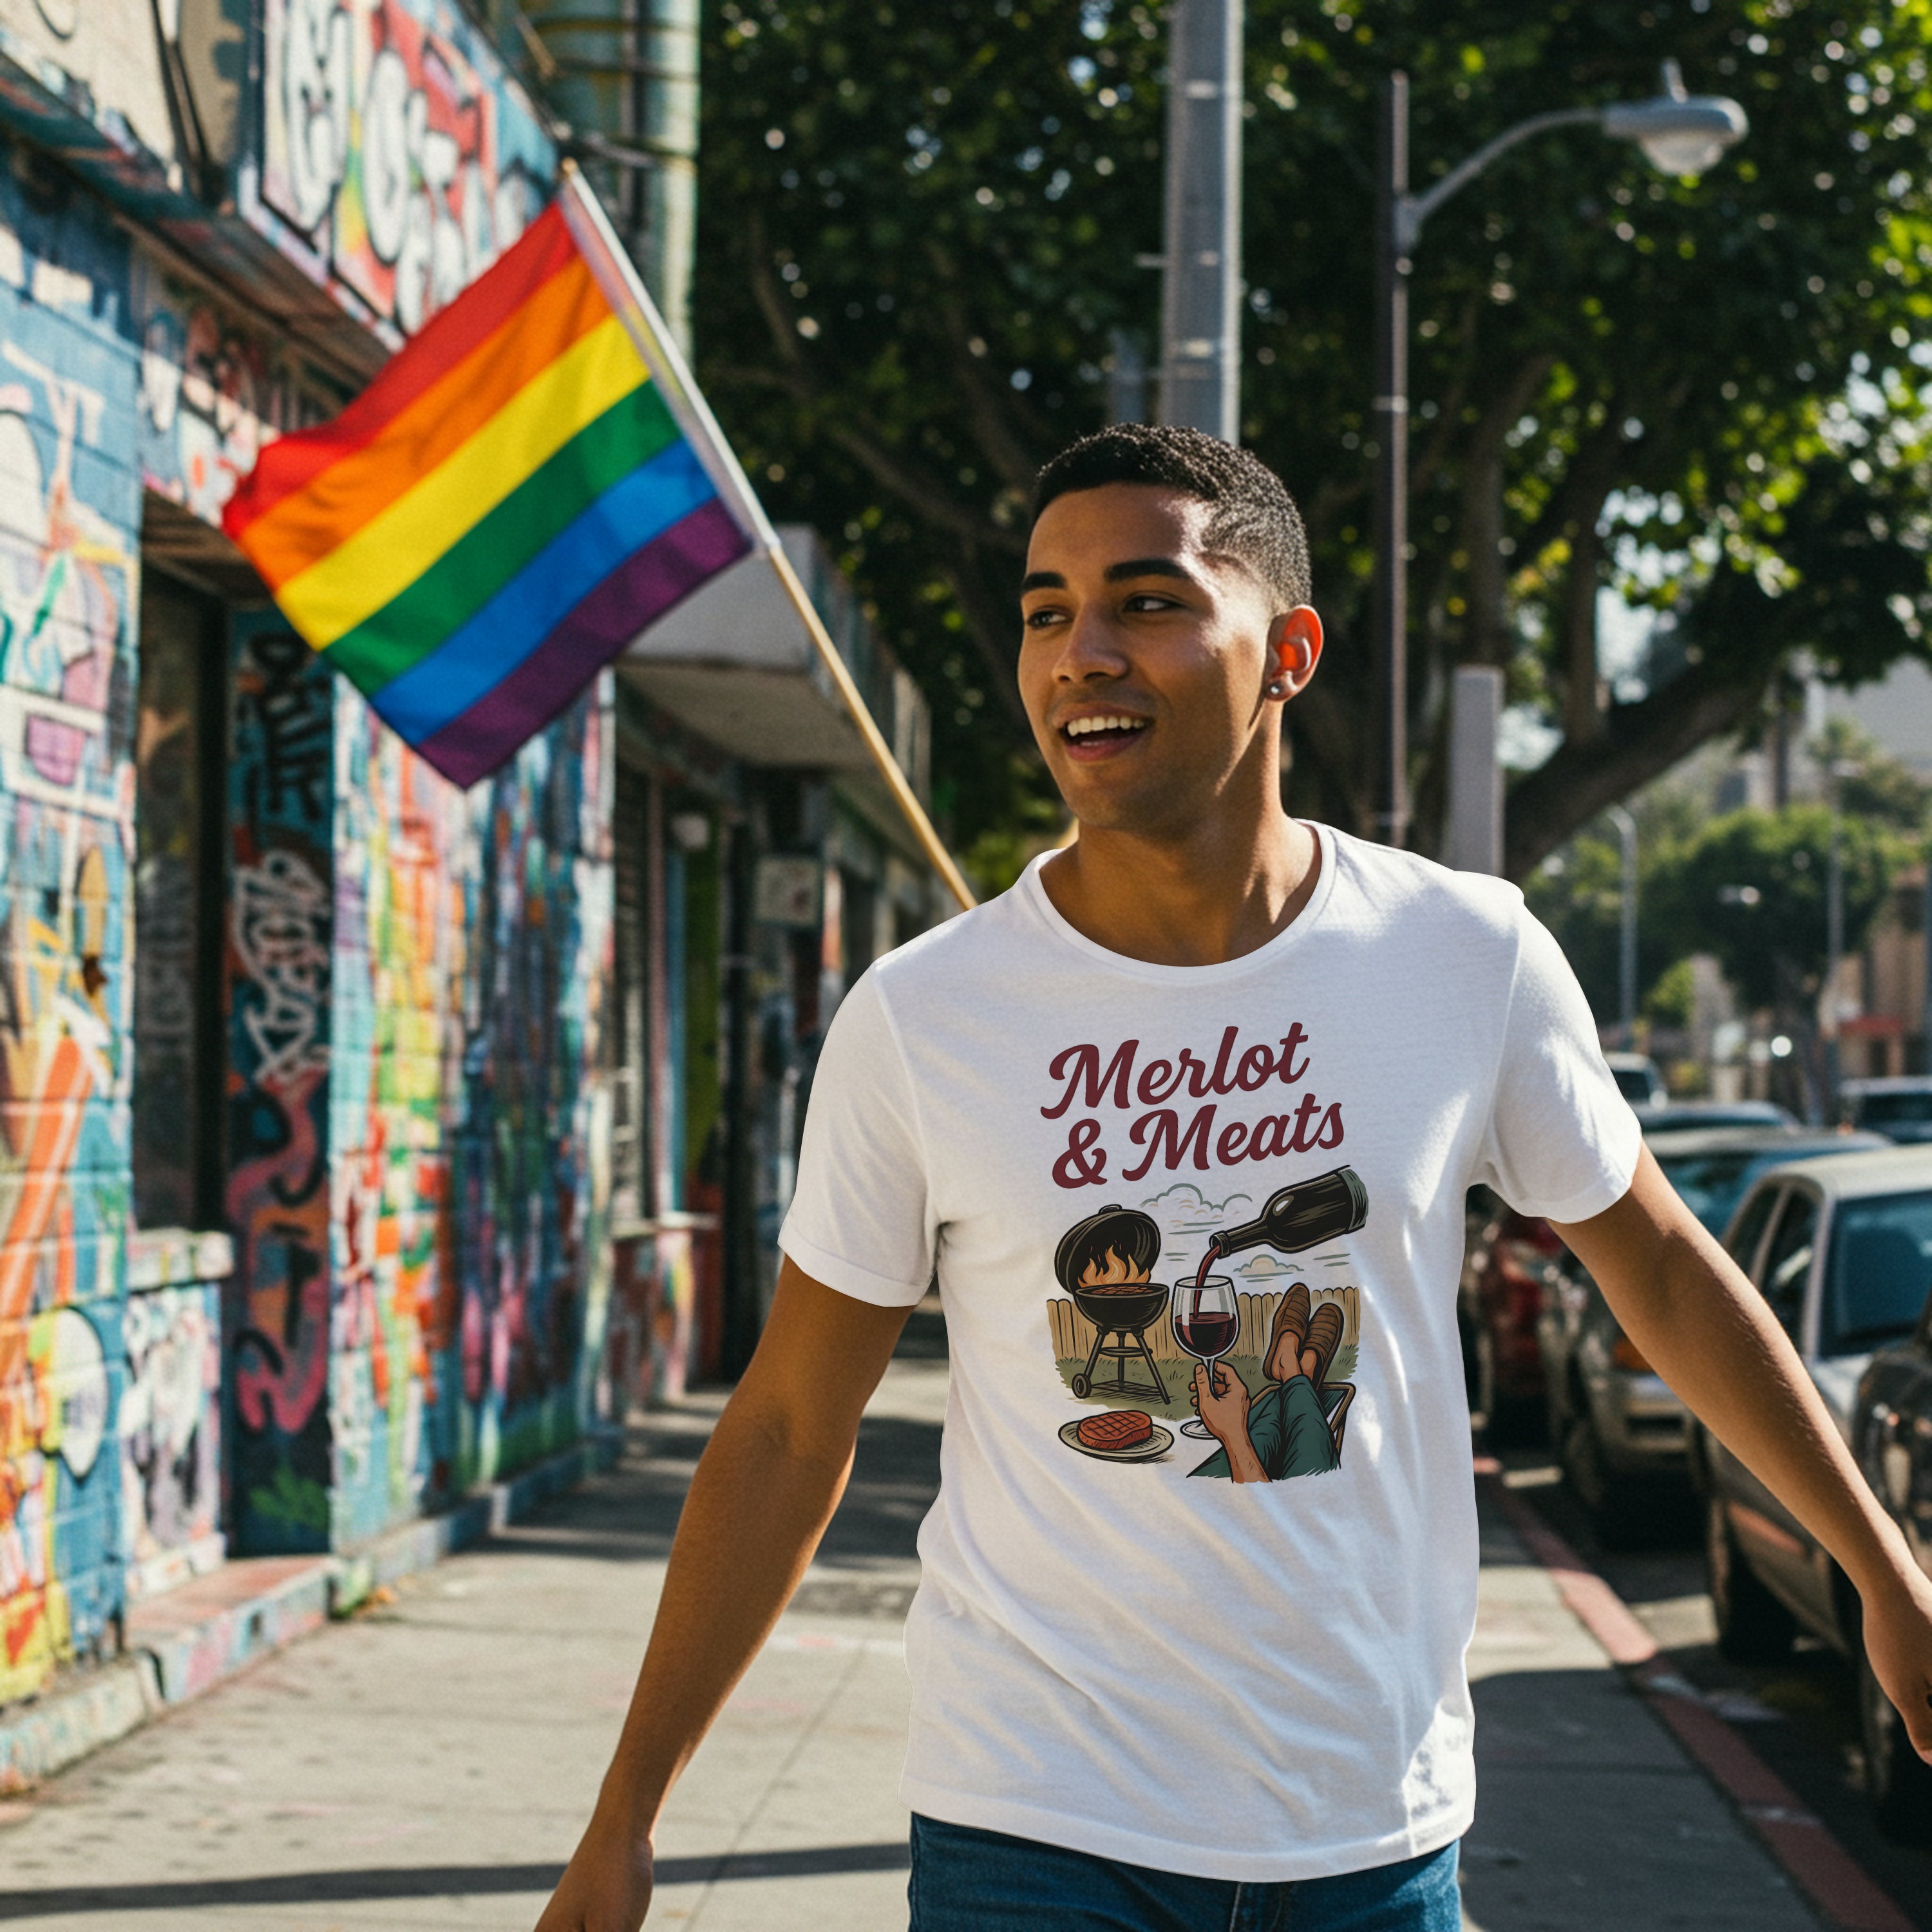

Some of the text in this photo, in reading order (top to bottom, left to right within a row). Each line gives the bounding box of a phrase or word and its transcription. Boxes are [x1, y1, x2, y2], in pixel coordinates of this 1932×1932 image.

[1040, 1022, 1310, 1120] Merlot
[1052, 1094, 1344, 1189] & Meats
